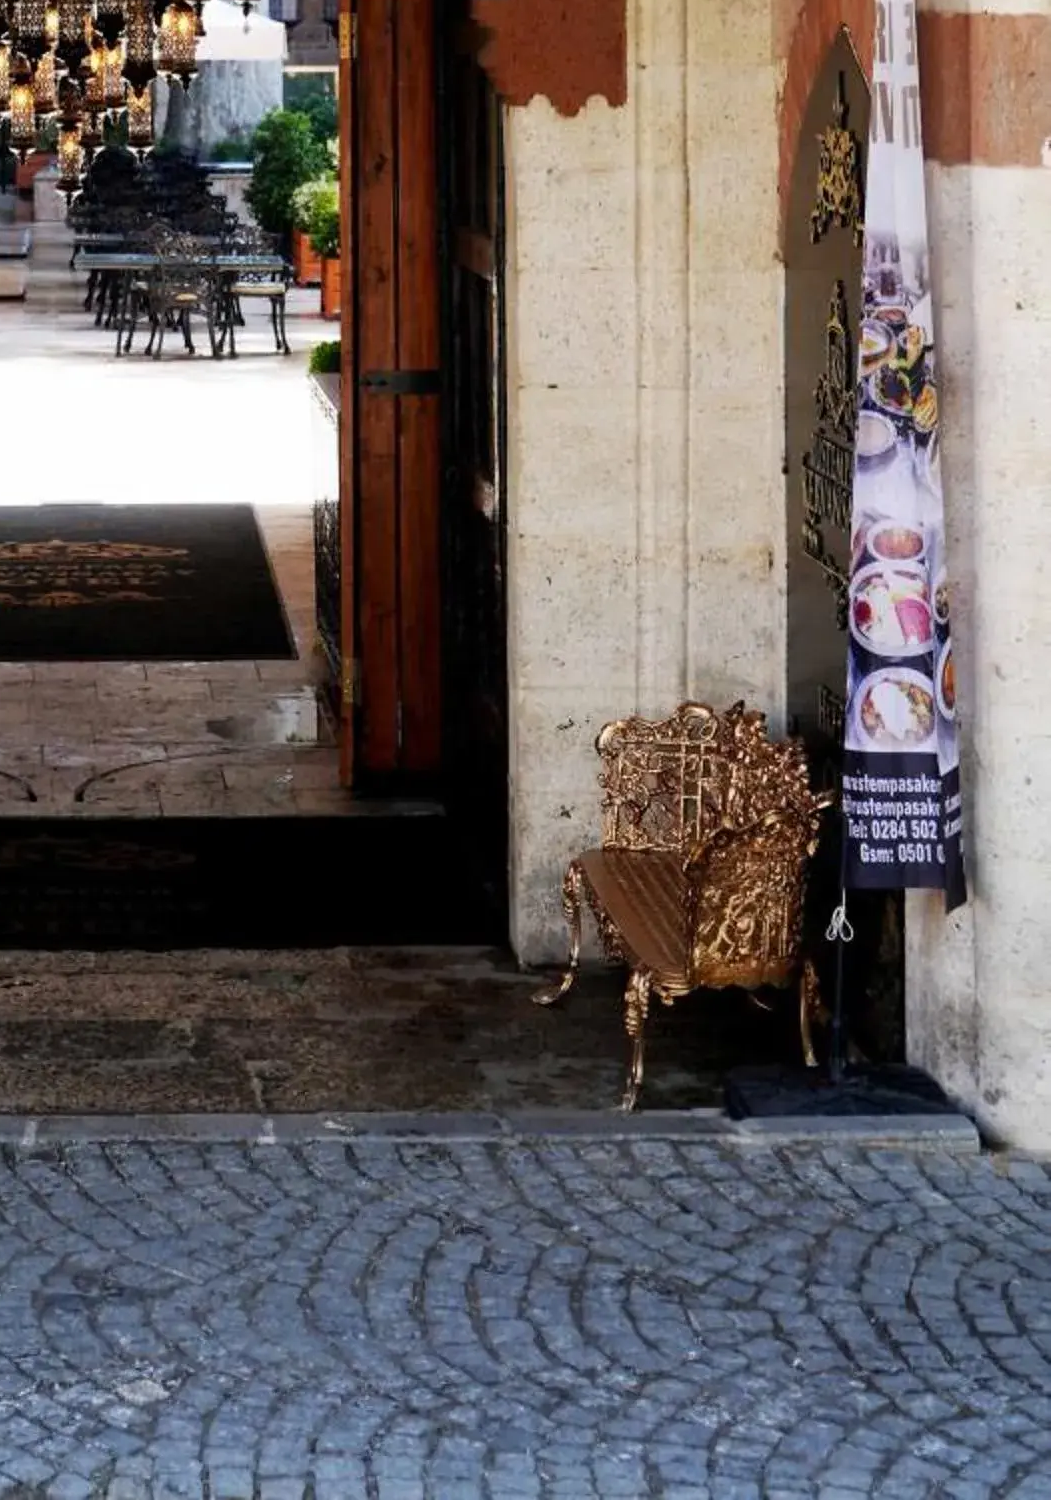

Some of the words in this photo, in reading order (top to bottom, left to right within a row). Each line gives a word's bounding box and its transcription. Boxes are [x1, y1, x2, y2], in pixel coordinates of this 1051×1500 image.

[871, 819, 908, 840] 0284
[911, 819, 938, 840] 502
[860, 842, 894, 863] Gsm:
[897, 843, 932, 863] 0501
